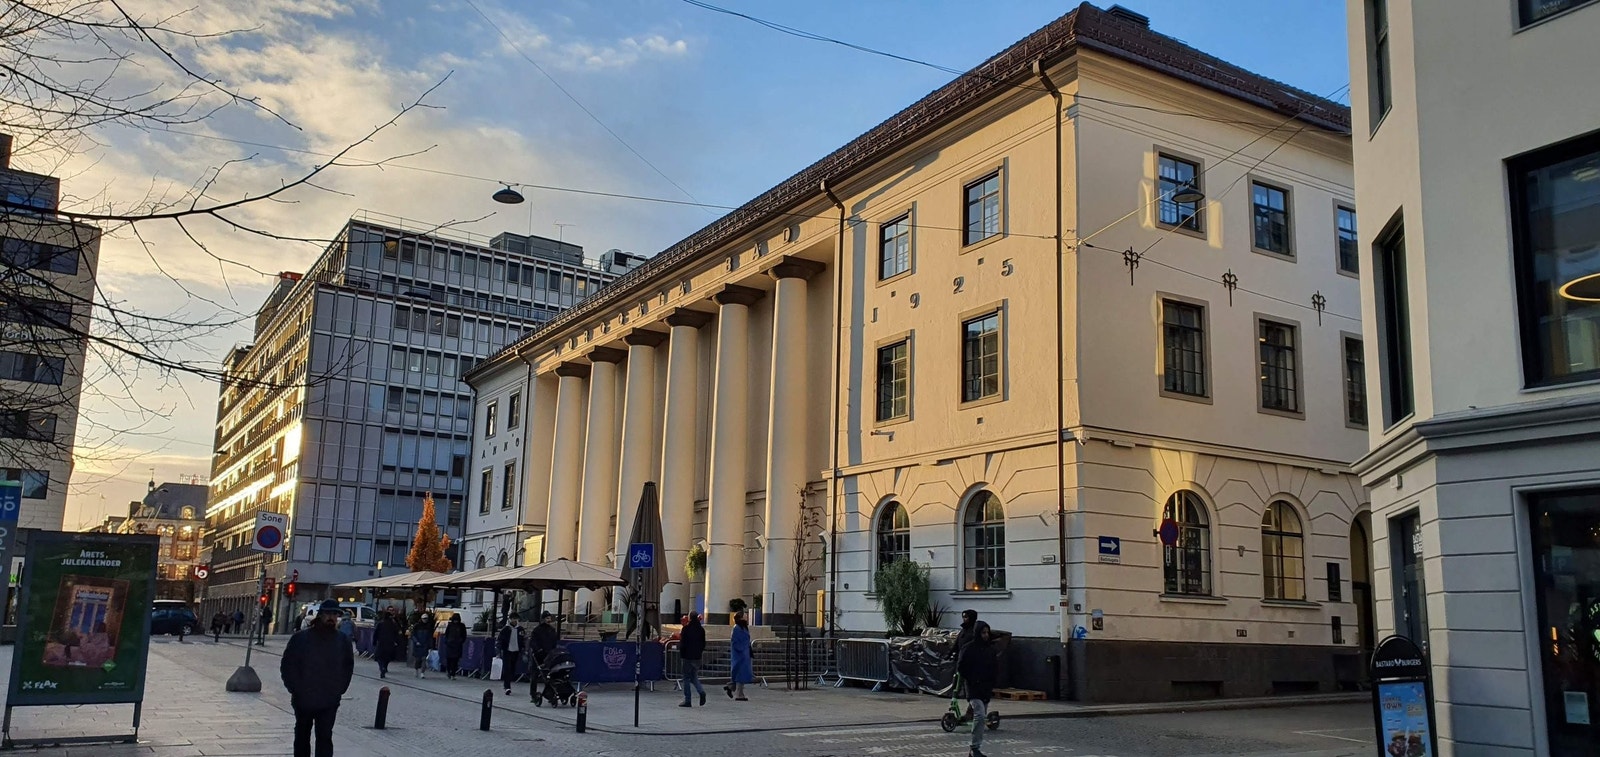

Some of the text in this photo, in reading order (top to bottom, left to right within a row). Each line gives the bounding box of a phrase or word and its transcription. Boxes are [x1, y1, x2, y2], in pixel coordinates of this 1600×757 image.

[725, 227, 791, 273] BAD
[870, 257, 1014, 324] 1925
[261, 513, 283, 524] Sone
[60, 559, 121, 567] JULEKALENDER
[1375, 658, 1422, 668] BASTARD BURGERS
[34, 680, 59, 689] FLAX
